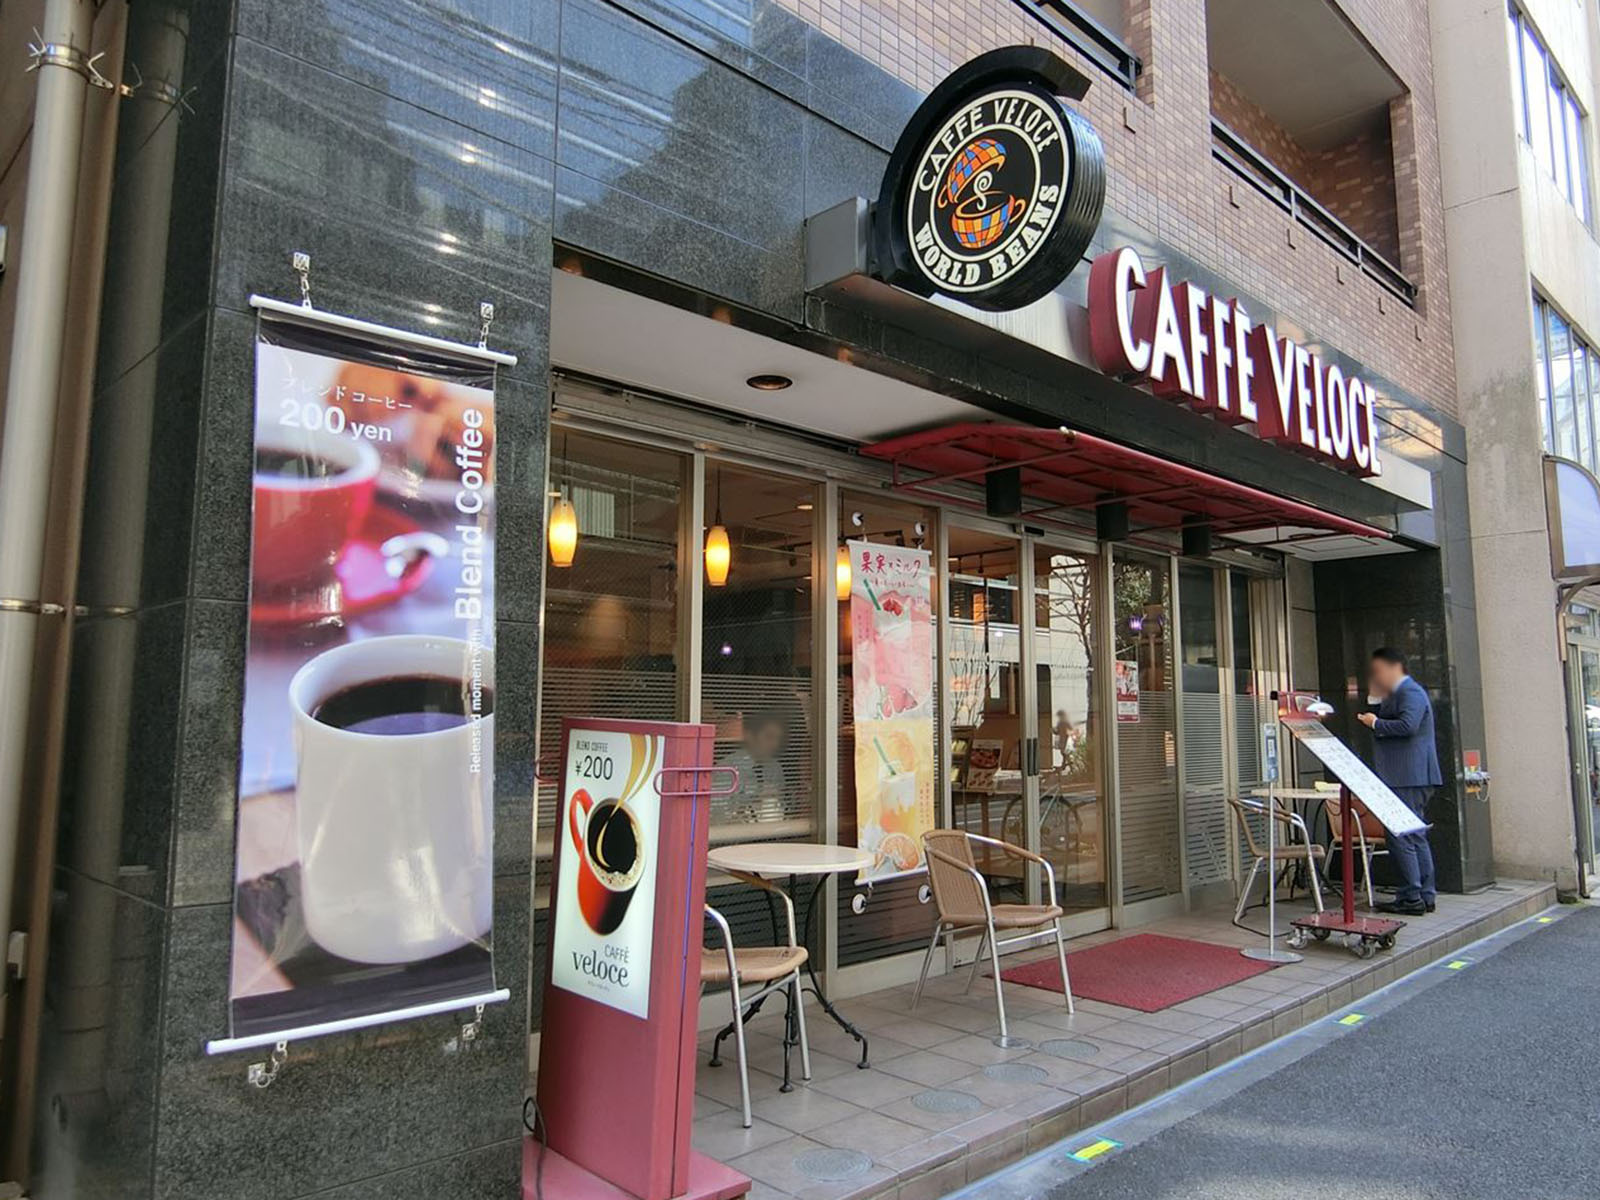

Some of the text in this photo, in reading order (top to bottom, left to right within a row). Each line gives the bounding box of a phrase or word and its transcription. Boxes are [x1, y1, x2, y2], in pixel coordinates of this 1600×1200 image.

[994, 97, 1059, 153] VELOCE
[914, 184, 1060, 286] WORLD BEANS
[279, 397, 392, 443] 200 yen
[1264, 323, 1383, 477] VELOCE
[454, 408, 485, 620] Blend Coffee
[471, 658, 482, 711] moment
[469, 714, 482, 774] Released
[572, 948, 630, 988] veloce
